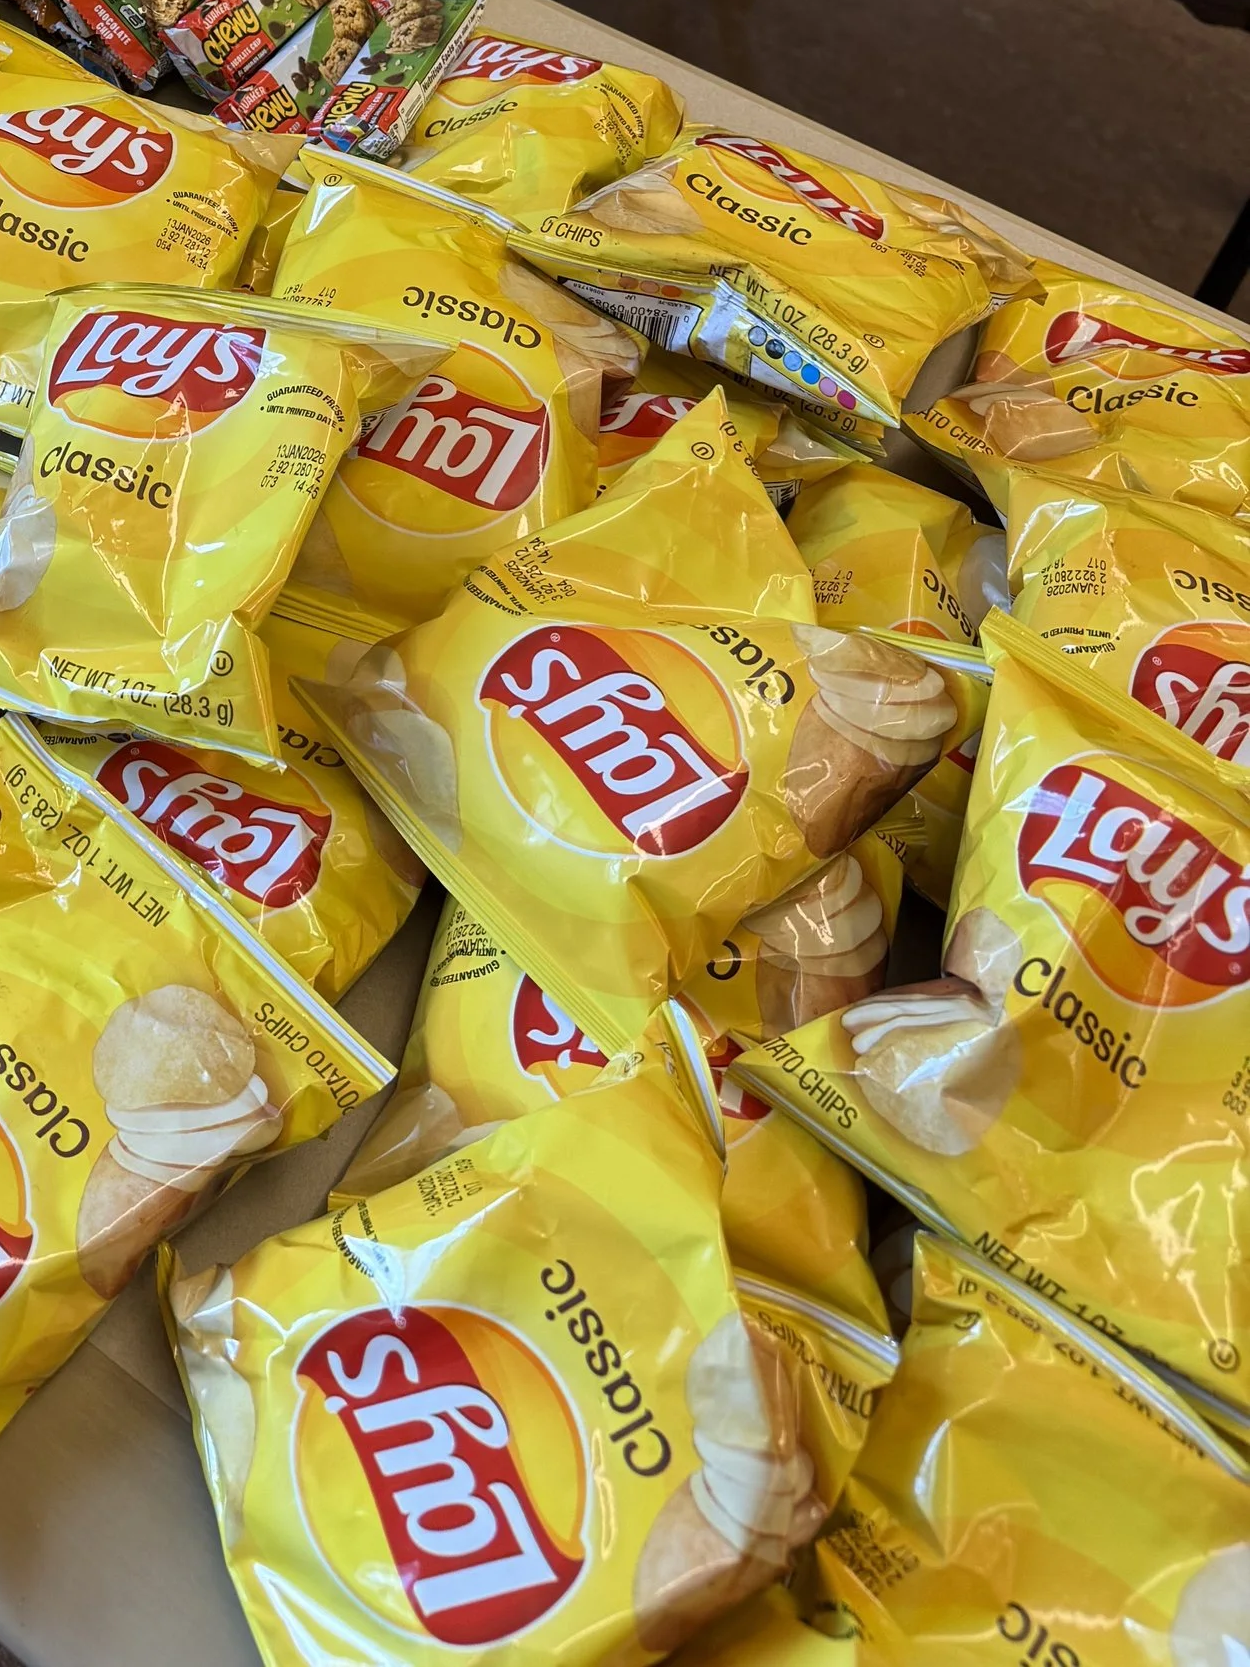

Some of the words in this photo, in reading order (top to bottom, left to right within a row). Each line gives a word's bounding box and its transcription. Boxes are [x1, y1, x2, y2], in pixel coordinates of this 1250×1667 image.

[94, 4, 131, 46] CHOCOLATE
[96, 22, 114, 40] CHIP
[422, 64, 443, 93] Nutrition
[441, 44, 456, 67] Facts
[424, 98, 519, 140] Classic
[173, 200, 190, 213] UNTIL
[191, 210, 216, 227] PRINTED
[686, 173, 813, 246] Classic
[156, 239, 171, 251] 054
[167, 218, 211, 245] 13JAN2026
[554, 221, 604, 248] CHIPS
[402, 285, 542, 351] Classic
[709, 263, 745, 285] NET
[745, 276, 770, 308] WT.
[782, 303, 805, 333] OZ.
[808, 319, 849, 361] (28.3
[848, 350, 870, 376] g)
[56, 313, 260, 397] Lay's
[266, 385, 324, 402] GUARANTEED
[323, 394, 345, 423] FRESH
[266, 405, 284, 414] UNTIL
[285, 406, 316, 419] PRINTED
[316, 413, 337, 429] DATE
[1066, 383, 1199, 415] Classic
[277, 444, 327, 465] 13JAN2026
[948, 424, 995, 456] CHIPS
[40, 441, 173, 510] Classic
[260, 475, 279, 488] 073
[504, 560, 549, 605] 13JAN2026
[1087, 558, 1107, 570] 017
[1047, 583, 1105, 597] 13JAN2026
[1086, 628, 1111, 639] UNTIL
[50, 655, 80, 684] NET
[128, 680, 158, 709] OZ.
[162, 691, 211, 720] (28.3
[216, 697, 235, 726] g)
[501, 647, 732, 834] Lay's
[4, 763, 26, 790] g)
[19, 784, 64, 832] (28.3
[61, 822, 93, 855] OZ.
[1028, 768, 1250, 951] Lay's
[99, 858, 135, 899] WT.
[140, 893, 171, 928] NET
[254, 1001, 306, 1056] CHIPS
[1013, 957, 1147, 1091] Classic
[798, 1068, 860, 1130] CHIPS
[974, 1232, 1025, 1275] NET
[539, 1257, 672, 1478] Classic
[324, 1334, 560, 1617] Lay's
